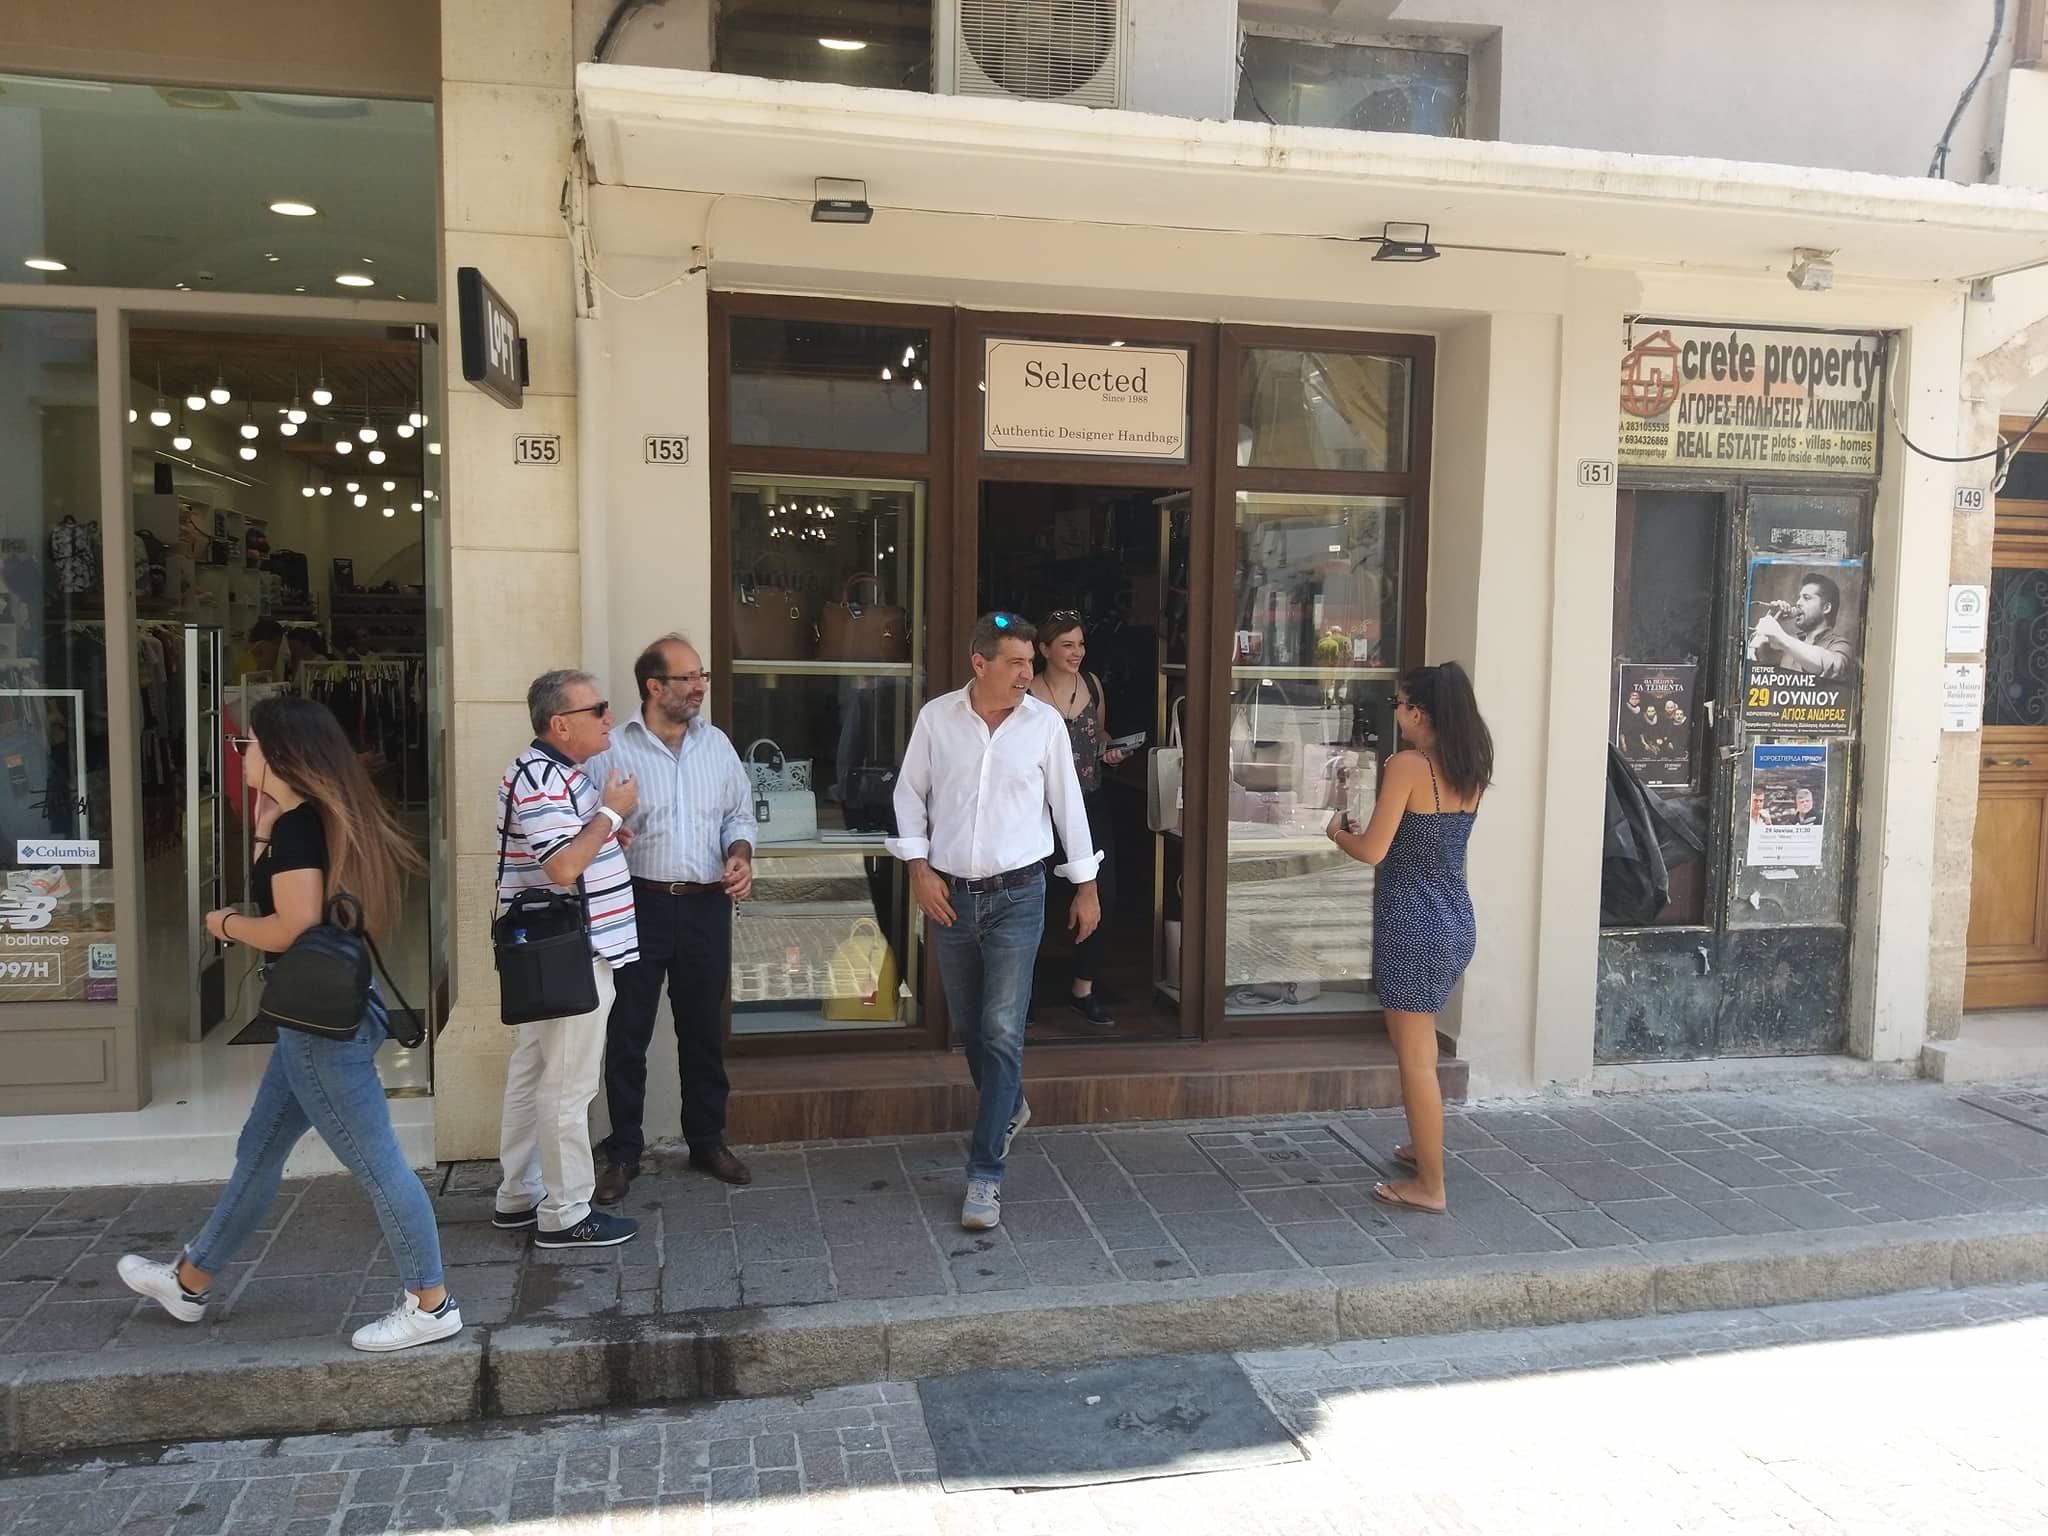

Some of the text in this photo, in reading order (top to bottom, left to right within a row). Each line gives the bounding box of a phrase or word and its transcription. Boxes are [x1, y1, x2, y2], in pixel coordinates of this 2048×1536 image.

[487, 299, 516, 382] LOFT
[1681, 330, 1877, 400] crete property
[1024, 360, 1149, 394] Selected
[1102, 393, 1149, 404] Since 1988
[1806, 399, 1875, 432] ΑΚΙΝΗΤΩΝ
[991, 424, 1180, 446] Authentic Designer Handbags
[1771, 433, 1873, 452] plots villas homes
[519, 439, 556, 461] 155
[649, 439, 684, 461] 153
[1676, 430, 1769, 461] REAL ESTATE
[1771, 450, 1786, 463] info
[1788, 451, 1812, 464] inside
[1583, 464, 1610, 482] 151
[1957, 490, 1981, 507] 149
[1750, 674, 1816, 687] ΜΑΡΟΥΛΗΣ
[1748, 687, 1839, 707] 29 ΙΟΥΝΙΟΥ
[1781, 708, 1807, 721] ΑΓΙΟΣ
[1807, 708, 1847, 721] ΑΝΔΡΕΑΣ
[35, 846, 96, 858] Columbia
[5, 933, 70, 946] balance
